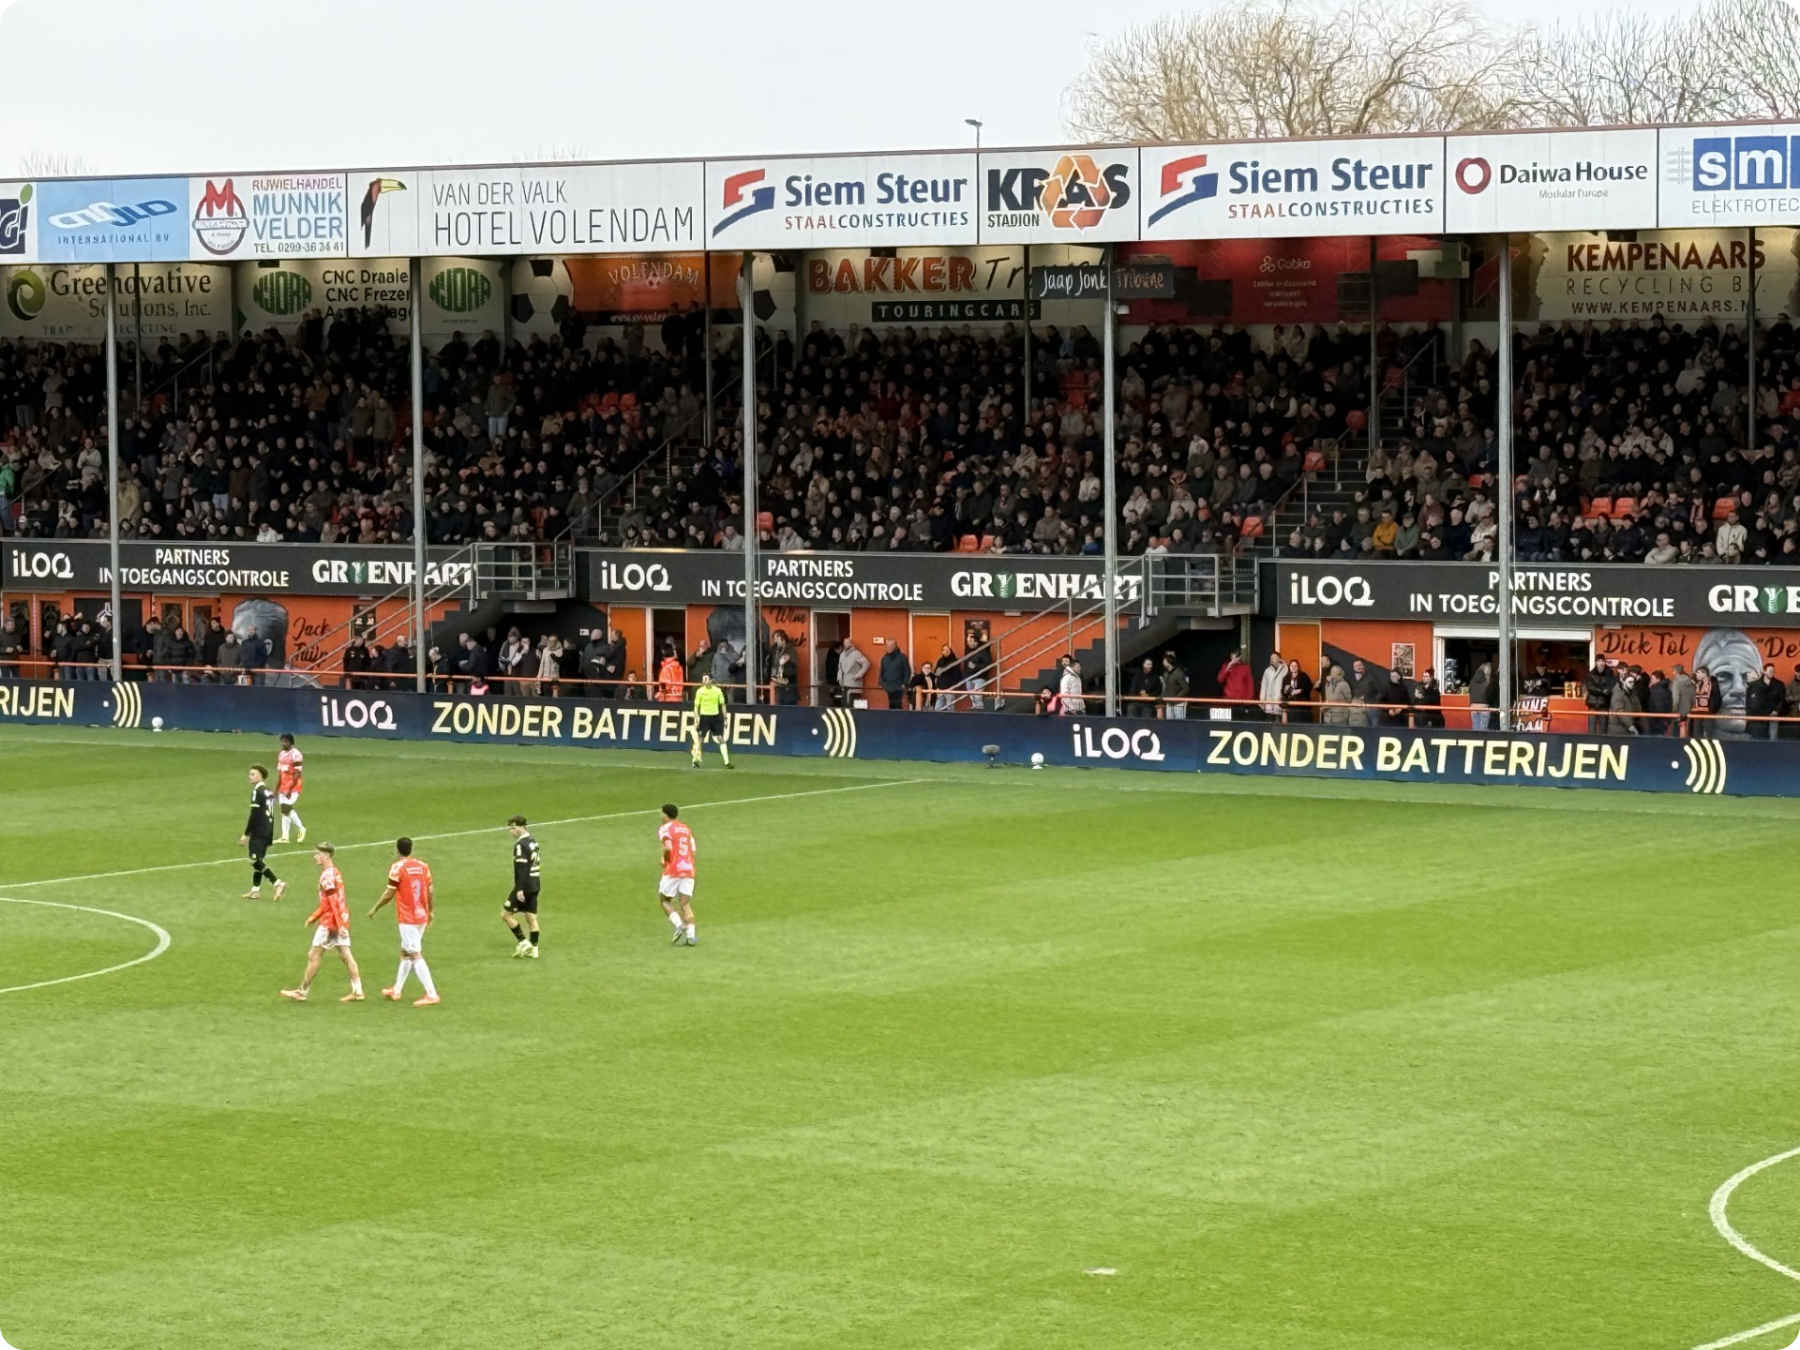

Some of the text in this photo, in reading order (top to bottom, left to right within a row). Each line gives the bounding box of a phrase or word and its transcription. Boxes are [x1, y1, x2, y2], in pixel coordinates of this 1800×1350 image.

[252, 177, 343, 191] RIJWIELHANDEL
[1229, 157, 1433, 194] Siem Steur
[1500, 161, 1648, 184] Daiwa House
[433, 180, 568, 206] VAN DER VALK
[785, 172, 968, 207] Siem Steur
[253, 192, 343, 216] MUNNIK
[1228, 198, 1434, 219] STAALCONSTRUCTIES
[253, 217, 343, 240] VELDER
[435, 206, 693, 247] HOTEL VOLENDAM
[785, 211, 968, 230] STAALCONSTRUCTIES
[988, 213, 1039, 228] STADION
[254, 243, 276, 254] TEL.
[1567, 240, 1766, 272] KEMPENAARS
[323, 270, 355, 285] CNC
[608, 262, 699, 286] VOLENDAM
[808, 255, 978, 294] BAKKER
[1039, 269, 1074, 297] Jaap
[1074, 269, 1108, 296] Jonk
[1567, 276, 1714, 295] RECYCLING
[326, 287, 359, 302] CNC
[184, 299, 212, 317] Inc.
[13, 550, 74, 579] iLOQ
[156, 549, 230, 566] PARTNERS
[767, 559, 854, 577] PARTNERS
[99, 567, 290, 587] IN TOEGANGSCONTROLE
[601, 561, 672, 591] iLOQ
[702, 579, 721, 597] IN
[1291, 572, 1375, 607] iLOQ
[1410, 593, 1675, 618] IN TOEGNGSCONTROLE
[292, 616, 331, 641] Jack
[1601, 631, 1653, 656] Dick
[1652, 631, 1690, 656] Tol
[321, 695, 397, 730] iLOQ
[431, 701, 777, 746] ZONDER BATTERJEN
[1073, 724, 1165, 761] iLOQ
[1207, 730, 1629, 782] ZONDER BATTERIJEN
